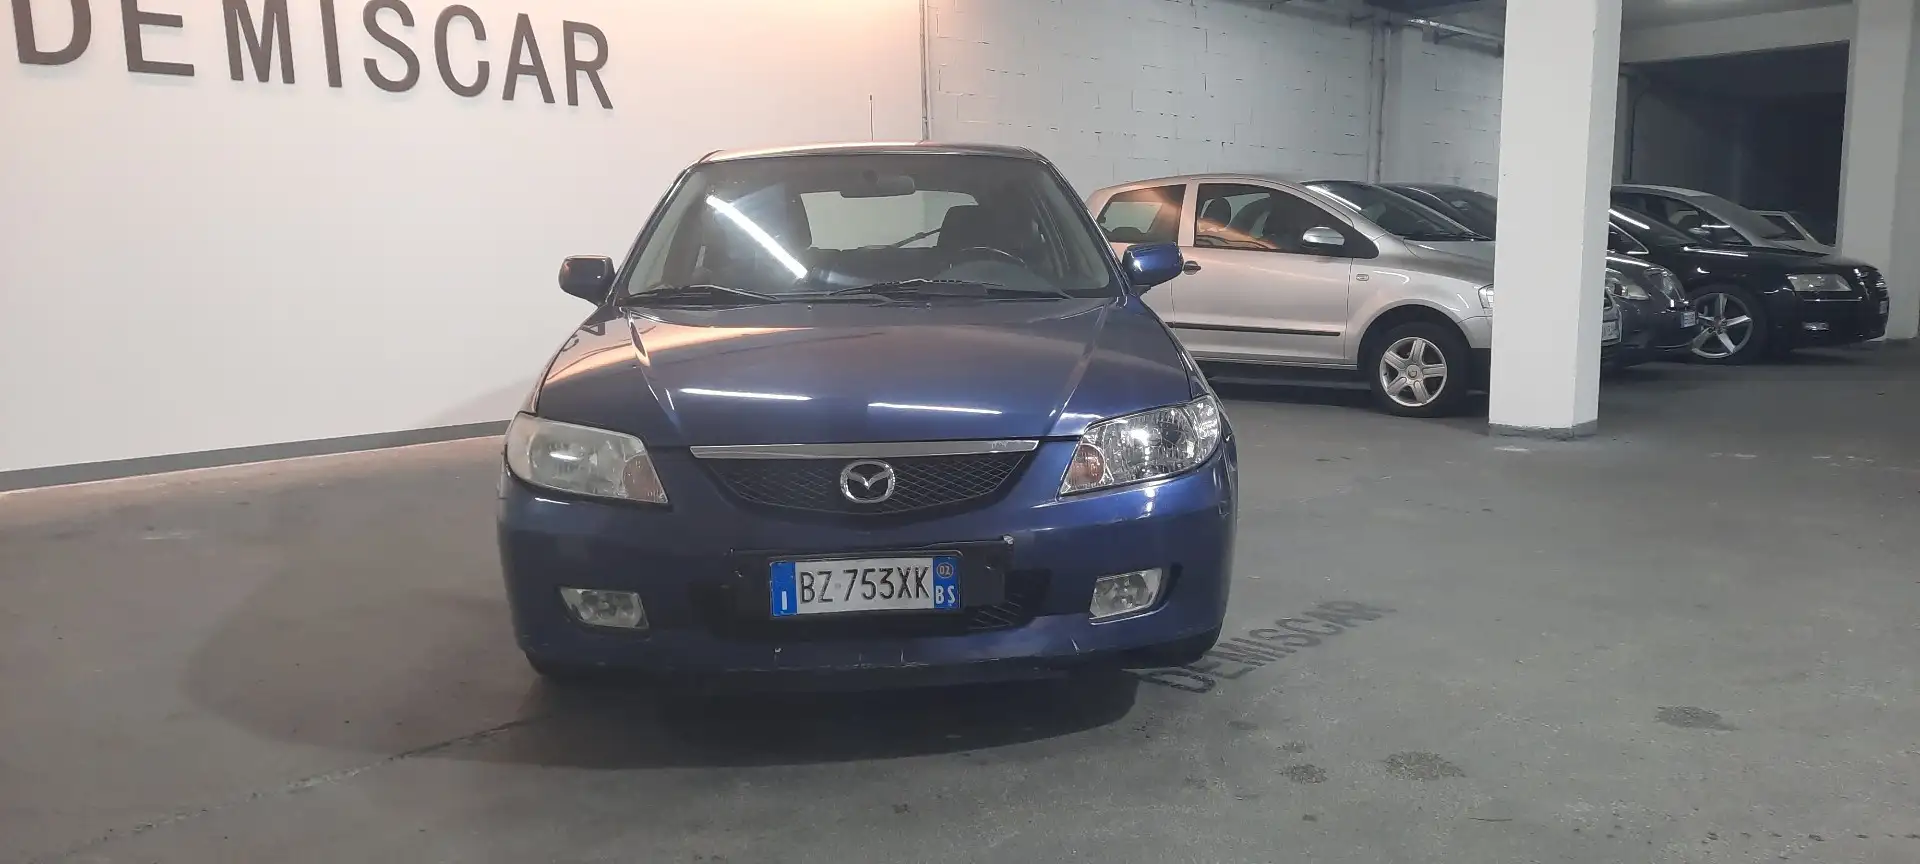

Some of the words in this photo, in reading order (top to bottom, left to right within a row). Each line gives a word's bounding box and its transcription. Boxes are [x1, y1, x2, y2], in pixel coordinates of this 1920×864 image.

[11, 0, 613, 109] DEMISCAR
[843, 566, 930, 602] 753XK
[936, 585, 956, 604] BS
